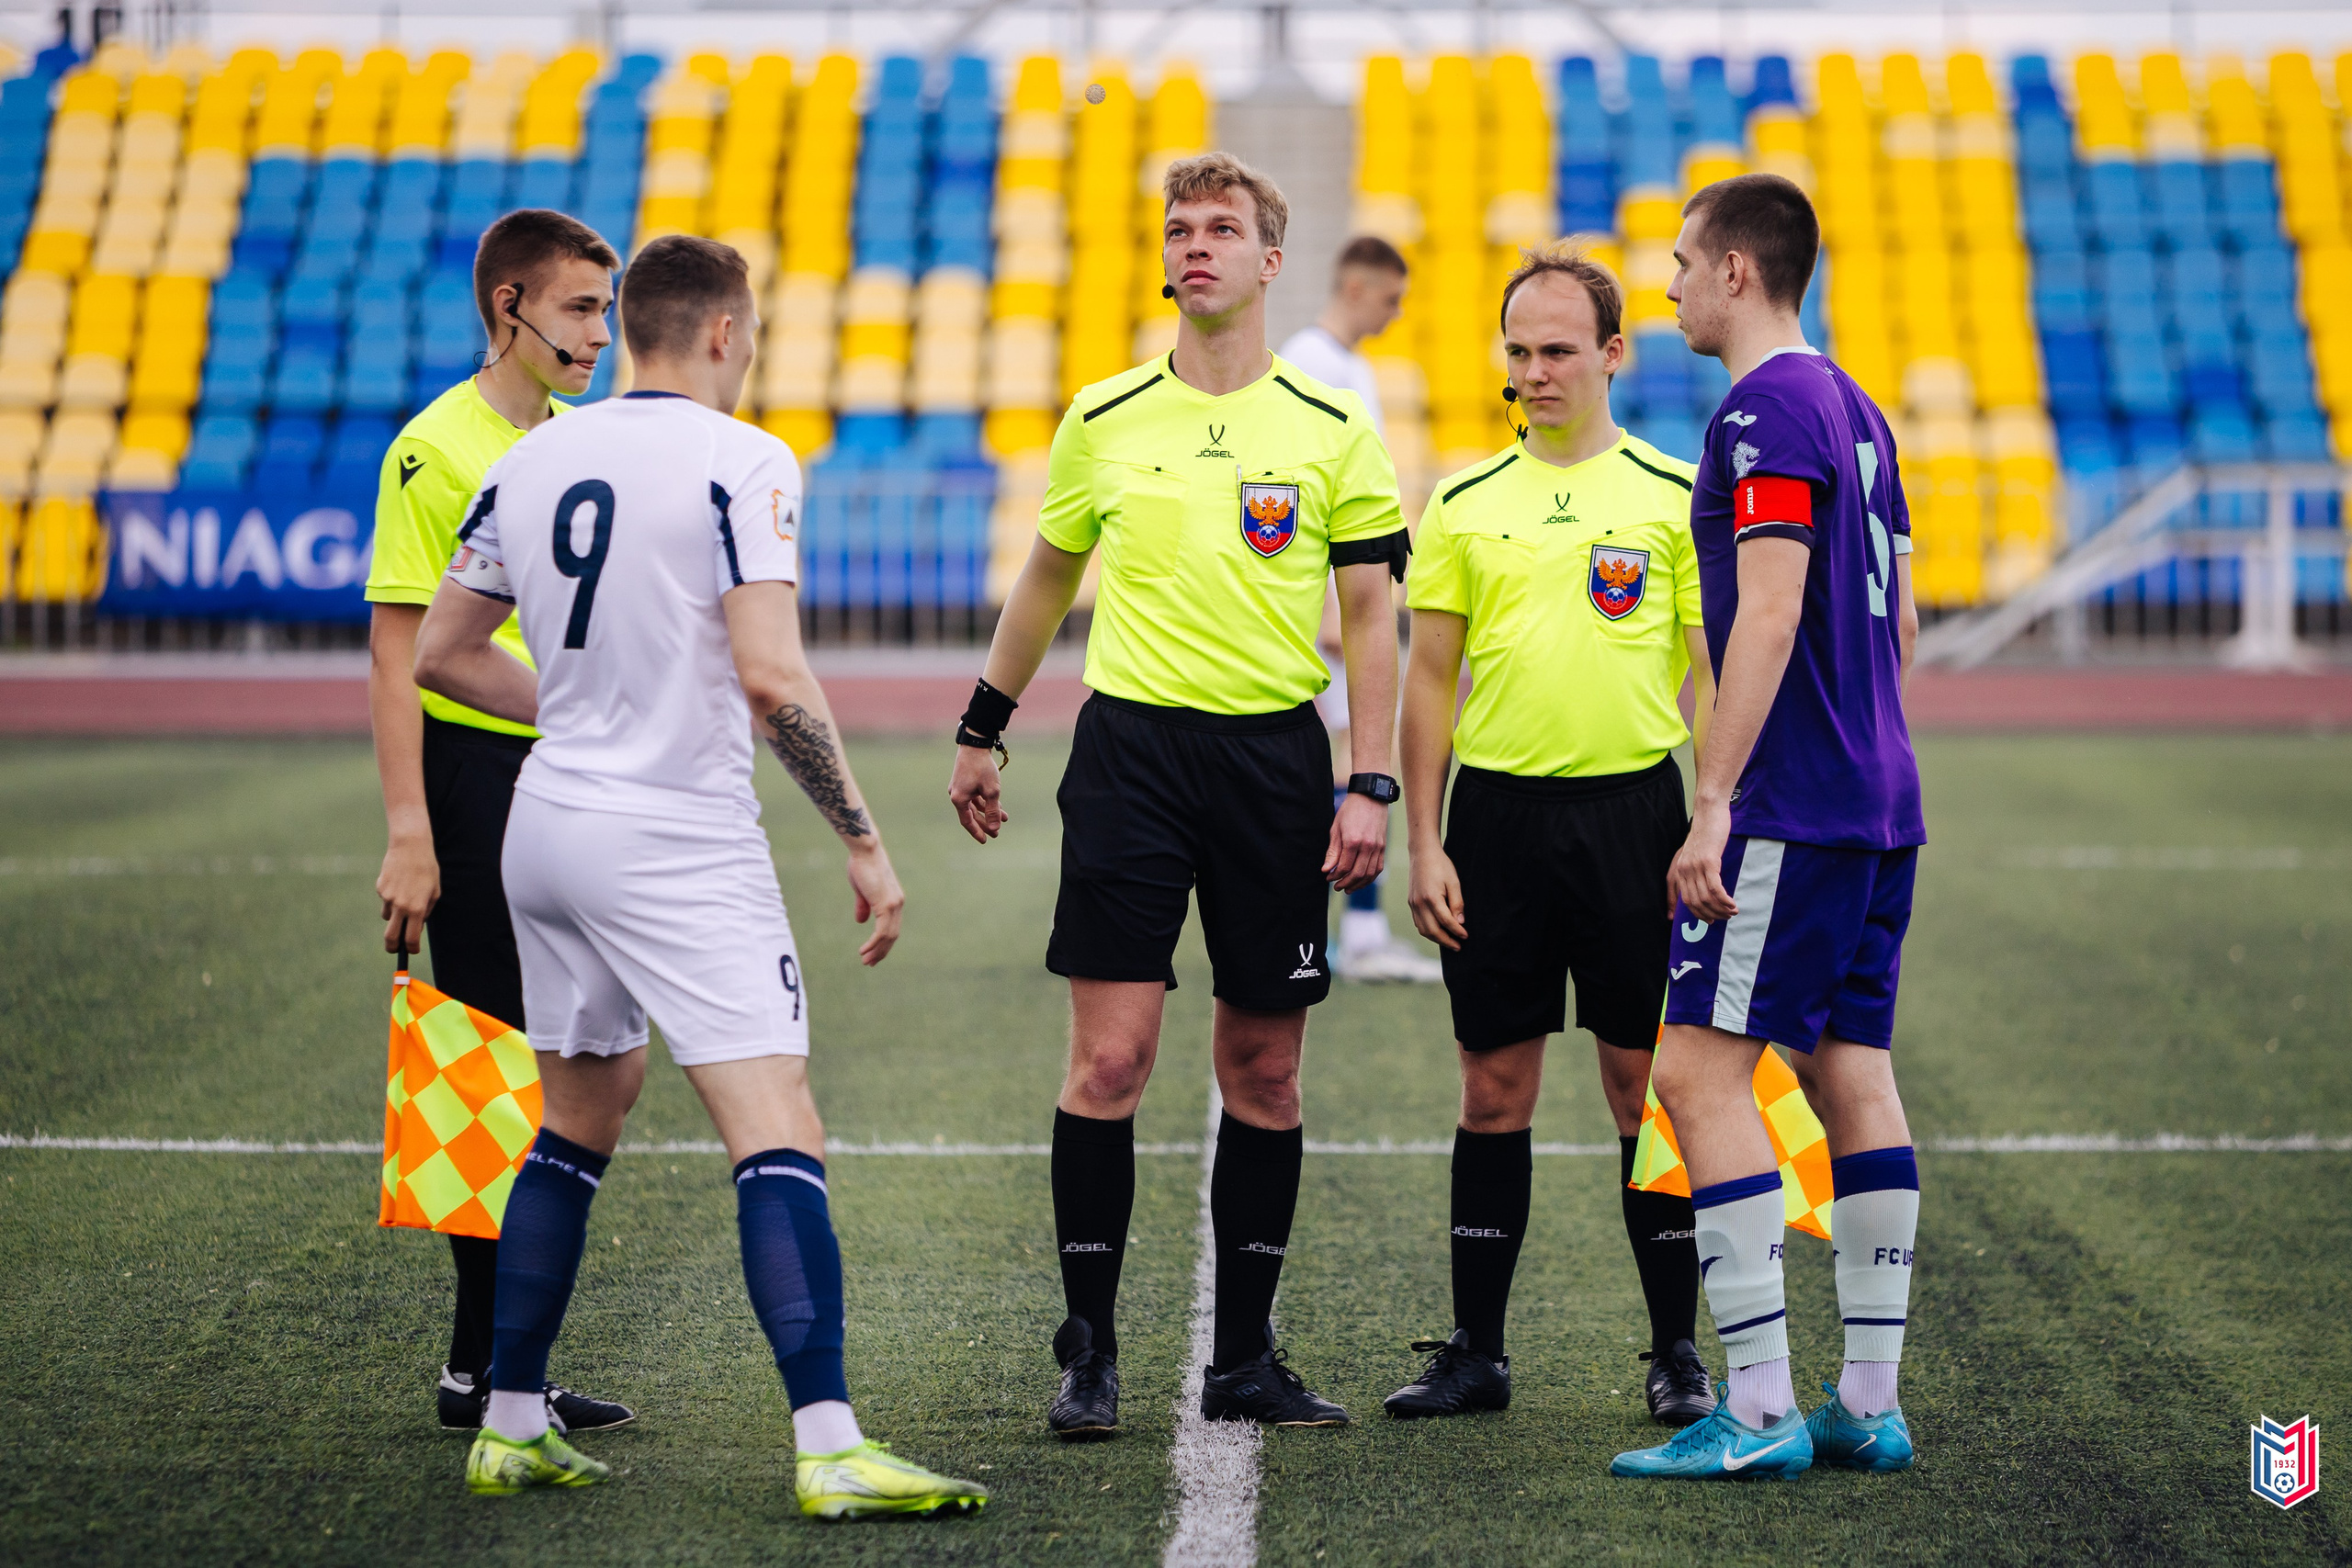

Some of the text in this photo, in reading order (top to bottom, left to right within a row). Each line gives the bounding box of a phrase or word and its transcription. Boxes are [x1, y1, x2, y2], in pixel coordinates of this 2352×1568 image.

[1195, 448, 1235, 458] JÖGEL
[1542, 515, 1579, 525] JÖGEL
[479, 560, 488, 570] 9
[553, 479, 616, 649] 9
[1289, 968, 1321, 979] JÖGEL
[779, 954, 799, 1021] 9
[526, 1152, 577, 1175] ELME
[1451, 1225, 1509, 1237] JÖGEL
[1650, 1229, 1696, 1240] JÖGE
[1061, 1242, 1113, 1253] JÖGEL
[1873, 1247, 1900, 1266] FC
